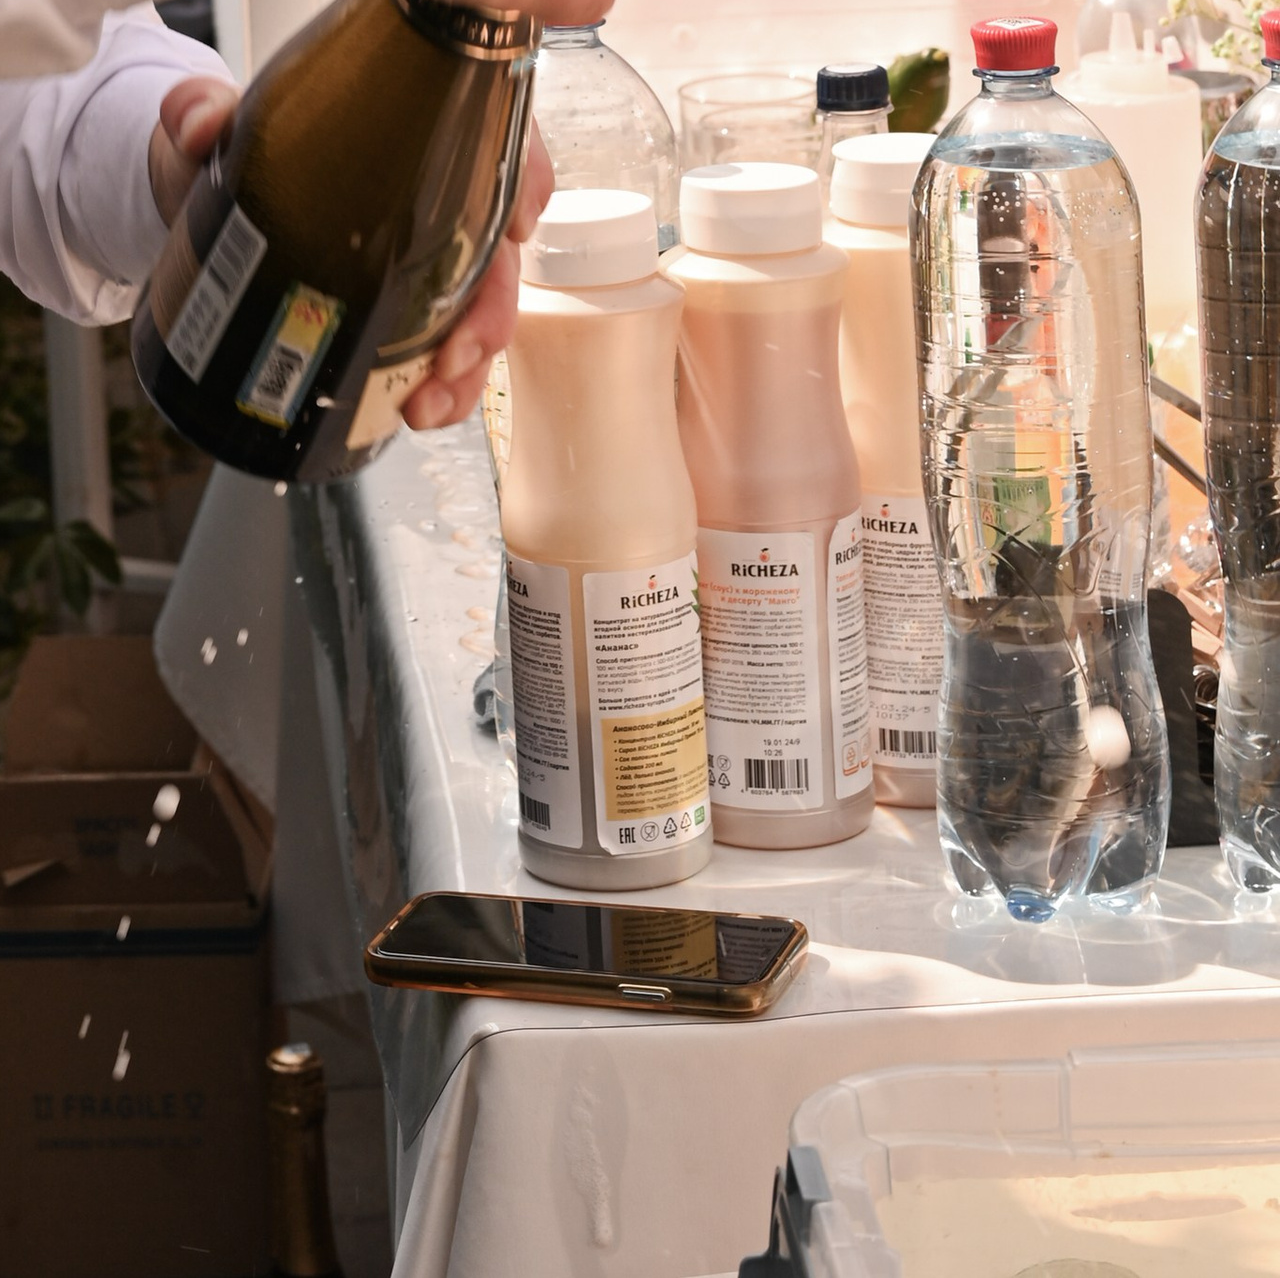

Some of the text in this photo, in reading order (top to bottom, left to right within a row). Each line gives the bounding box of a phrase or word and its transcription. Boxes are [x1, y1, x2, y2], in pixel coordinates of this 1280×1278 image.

[731, 563, 799, 577] RiCHEZA
[743, 588, 800, 596] мороженому
[727, 597, 762, 606] десерту
[593, 618, 631, 626] Концентрат
[640, 609, 674, 622] натуральной
[622, 623, 645, 631] основе
[594, 631, 625, 639] напитков
[595, 642, 639, 653] «Ананас»
[619, 652, 663, 663] приготовления
[624, 694, 652, 703] рецептов
